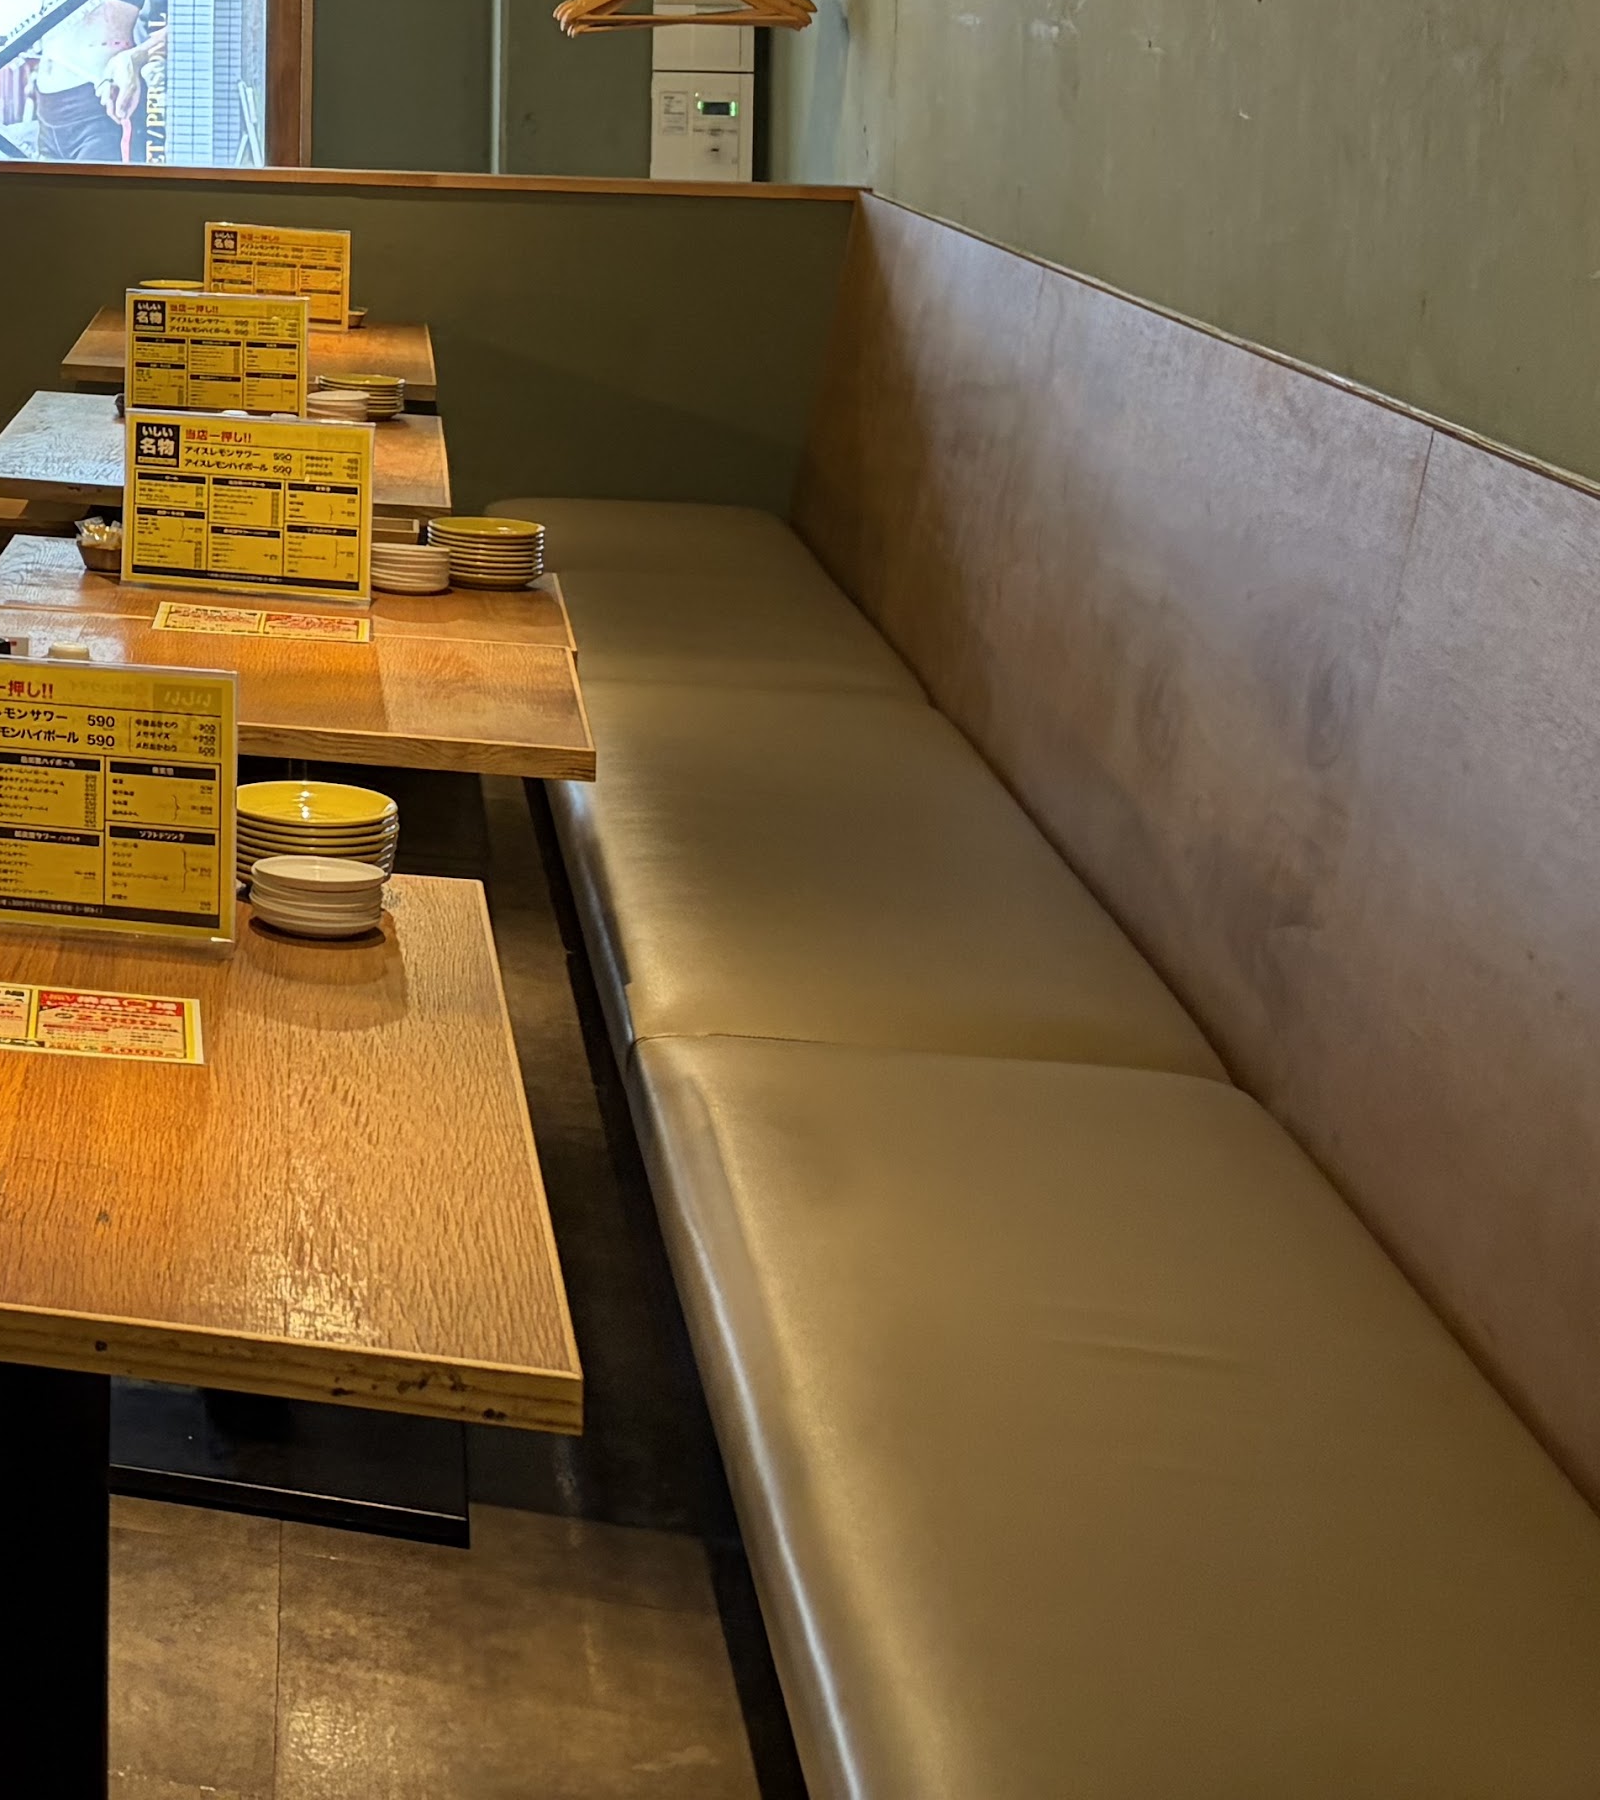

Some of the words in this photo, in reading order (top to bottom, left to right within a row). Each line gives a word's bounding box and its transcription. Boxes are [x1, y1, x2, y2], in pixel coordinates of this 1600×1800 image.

[136, 311, 163, 325] 名物
[141, 425, 174, 438] いしい
[139, 438, 175, 456] 名物
[184, 446, 261, 459] アイスレモンサワー
[87, 714, 116, 728] 590
[86, 734, 115, 748] 590
